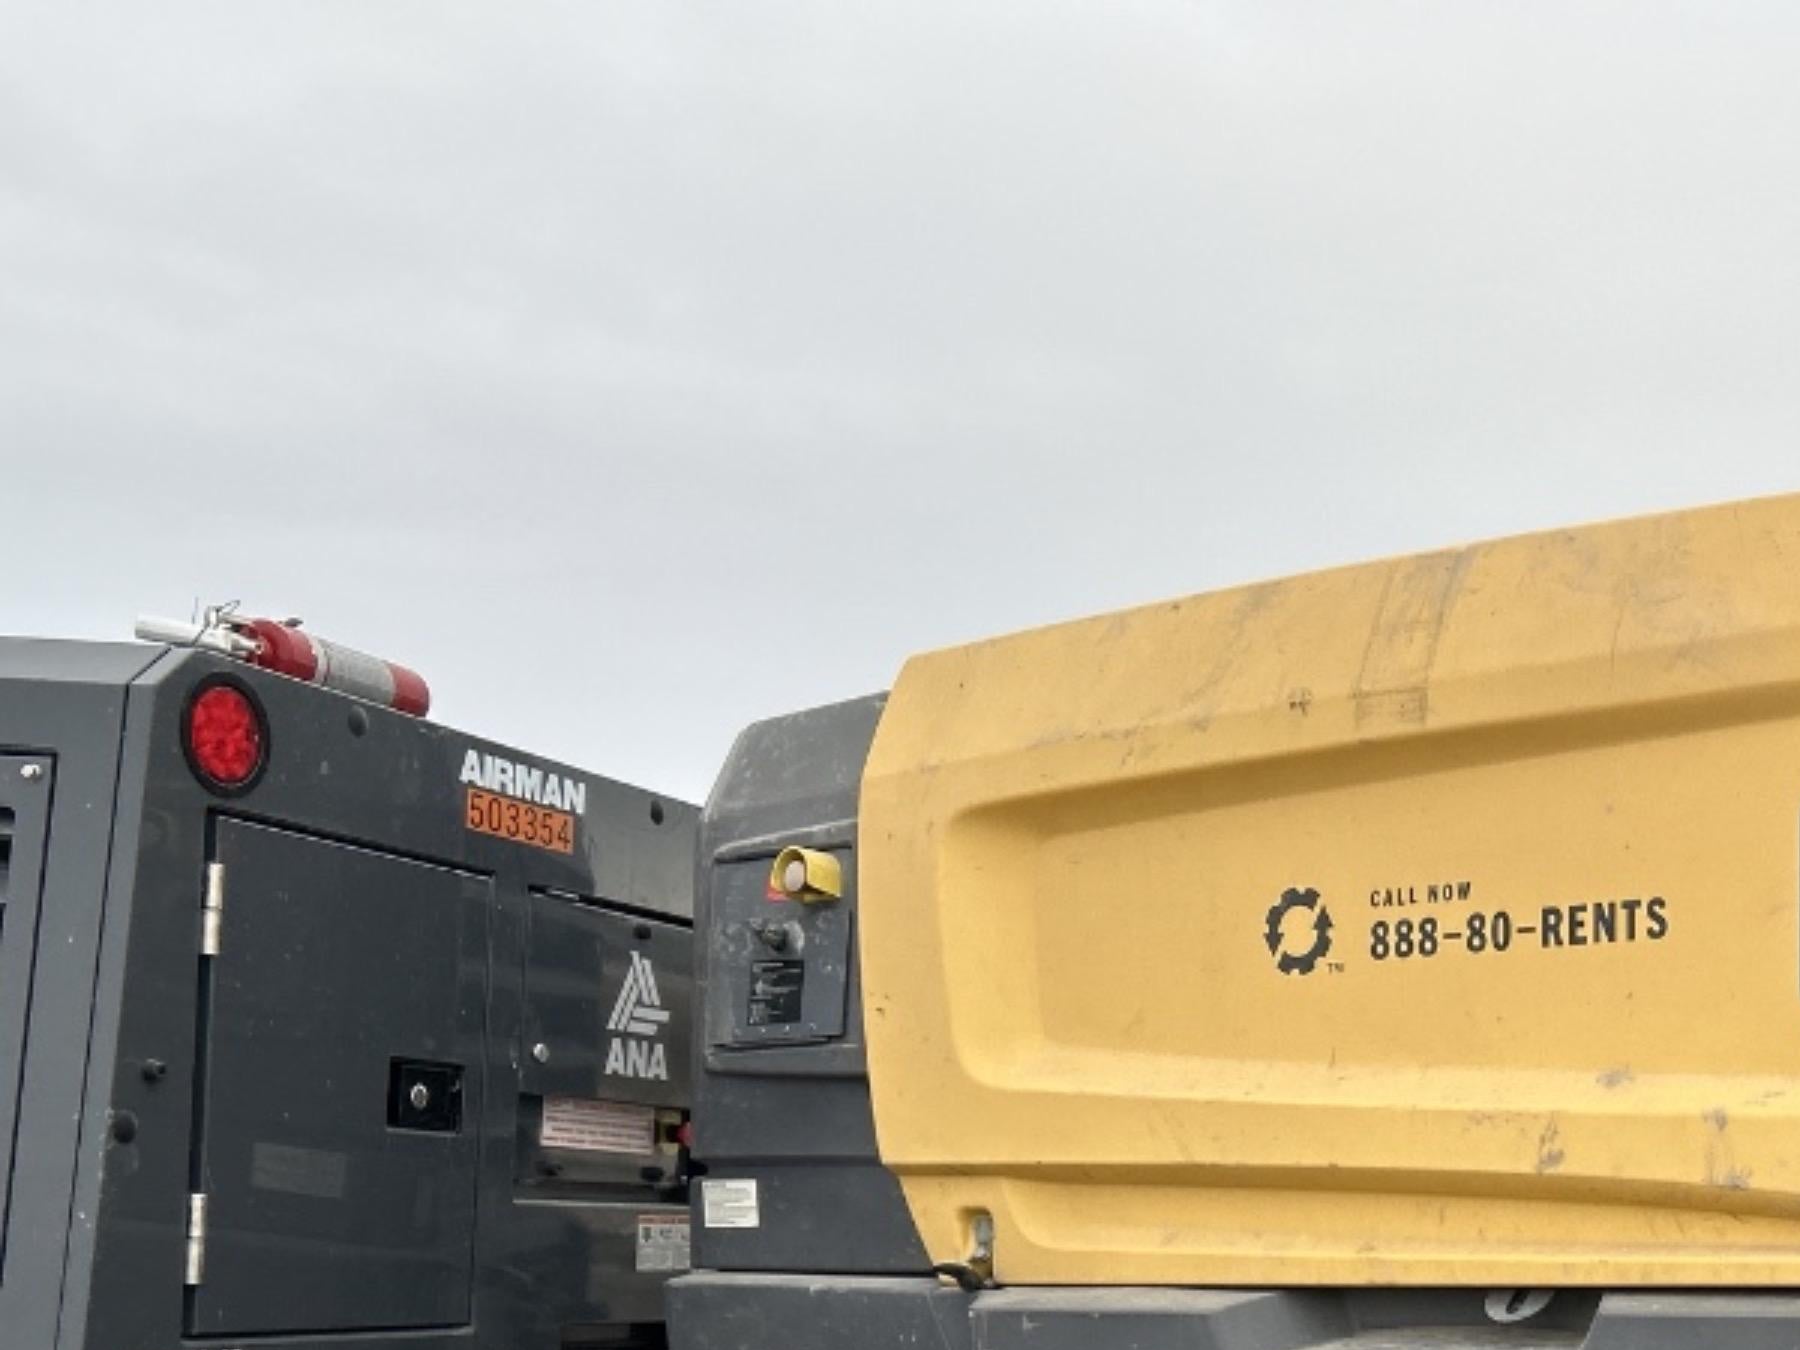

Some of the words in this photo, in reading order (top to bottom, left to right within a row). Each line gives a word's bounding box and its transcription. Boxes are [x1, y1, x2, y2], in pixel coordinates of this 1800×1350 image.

[459, 748, 586, 814] AIRMAN
[469, 792, 572, 850] 503354
[1370, 886, 1418, 907] CALL
[1427, 881, 1472, 903] NOW
[1369, 897, 1669, 960] 888-80-RENTS
[605, 1037, 669, 1081] ANA
